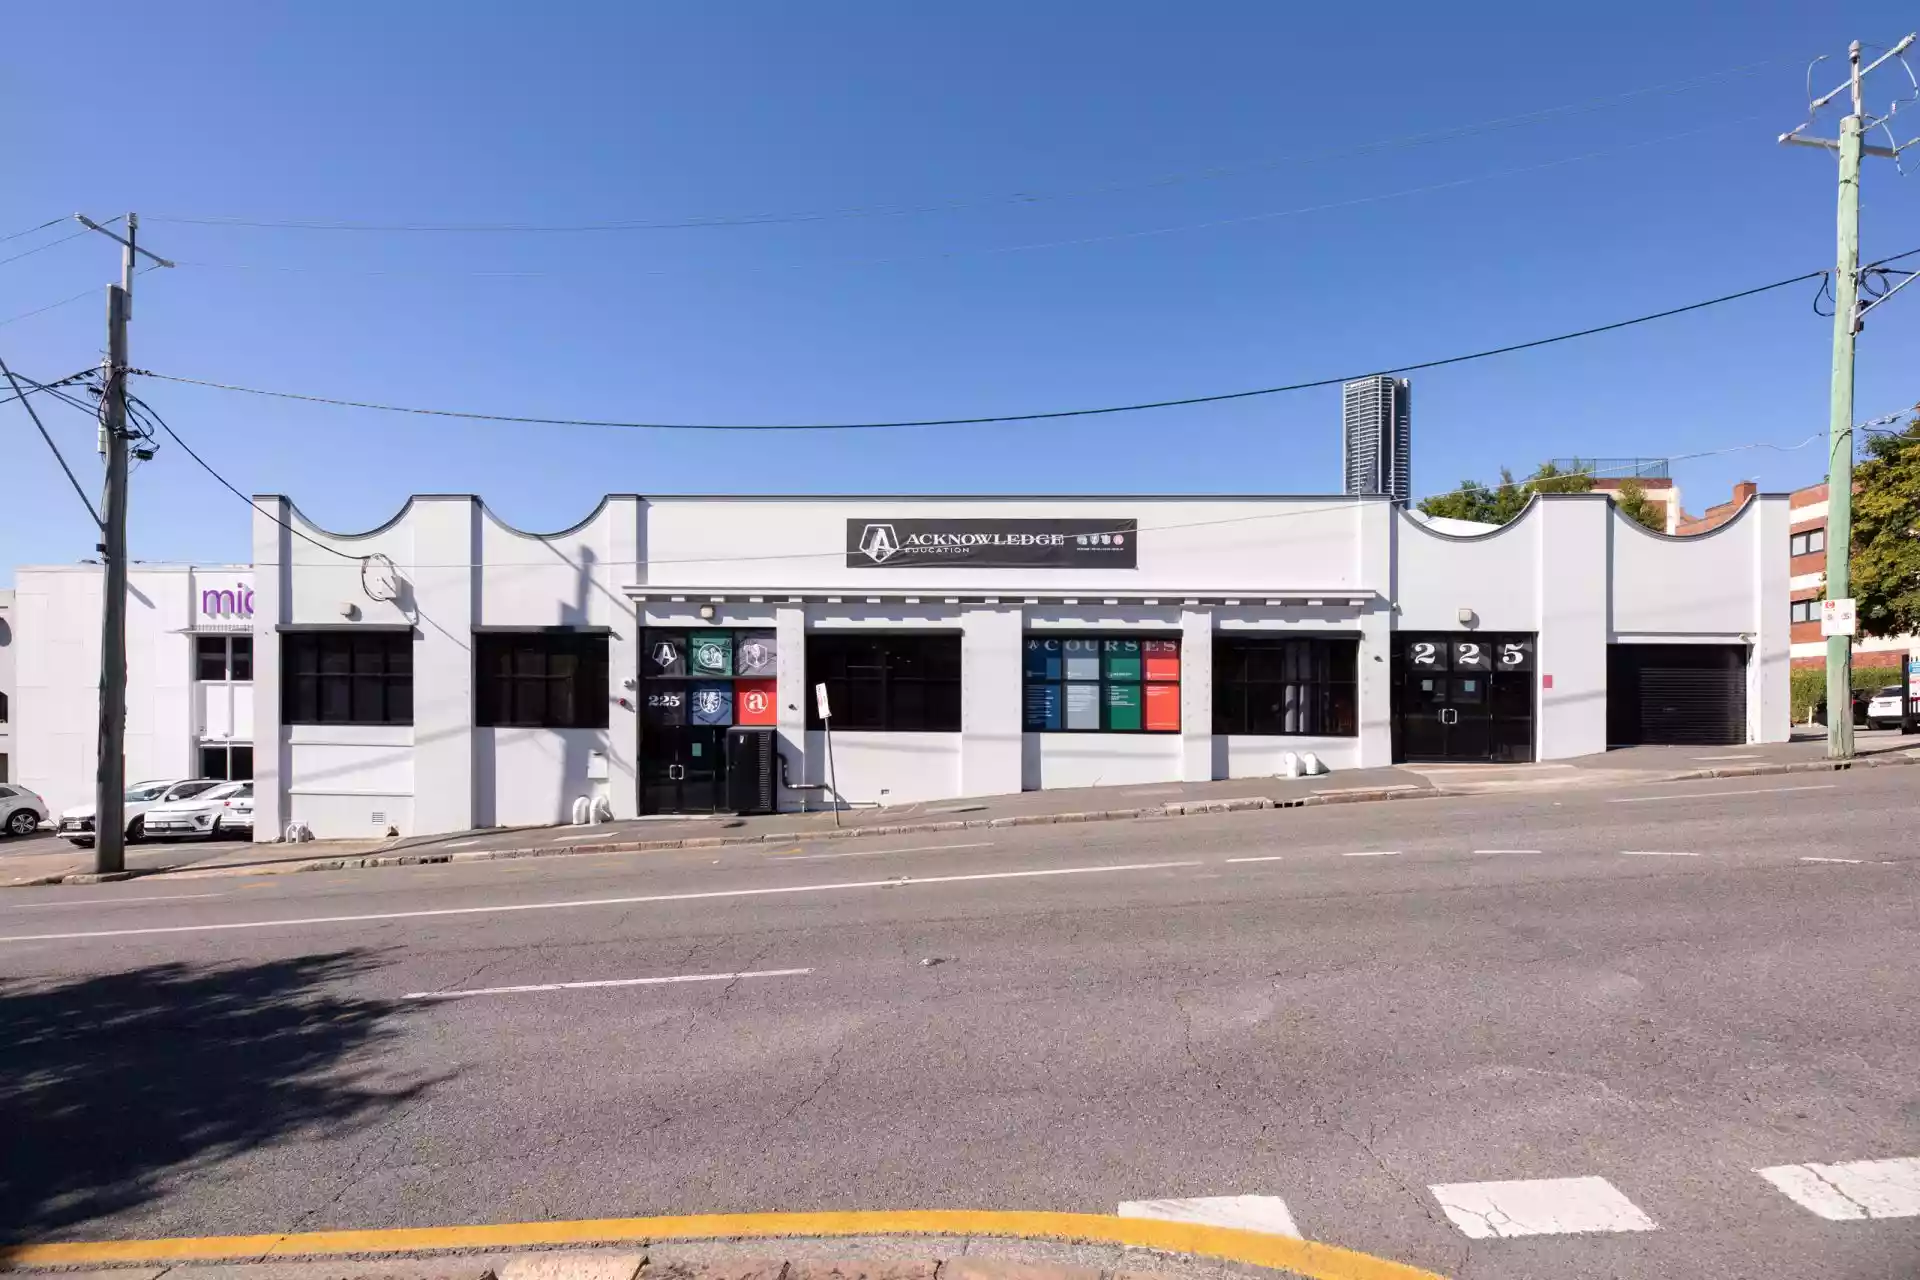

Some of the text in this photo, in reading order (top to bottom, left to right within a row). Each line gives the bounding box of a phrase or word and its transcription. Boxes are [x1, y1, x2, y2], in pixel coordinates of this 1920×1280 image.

[906, 534, 1064, 546] ACKNOWLEDGE
[1044, 639, 1176, 652] COURSES
[648, 694, 681, 708] 225
